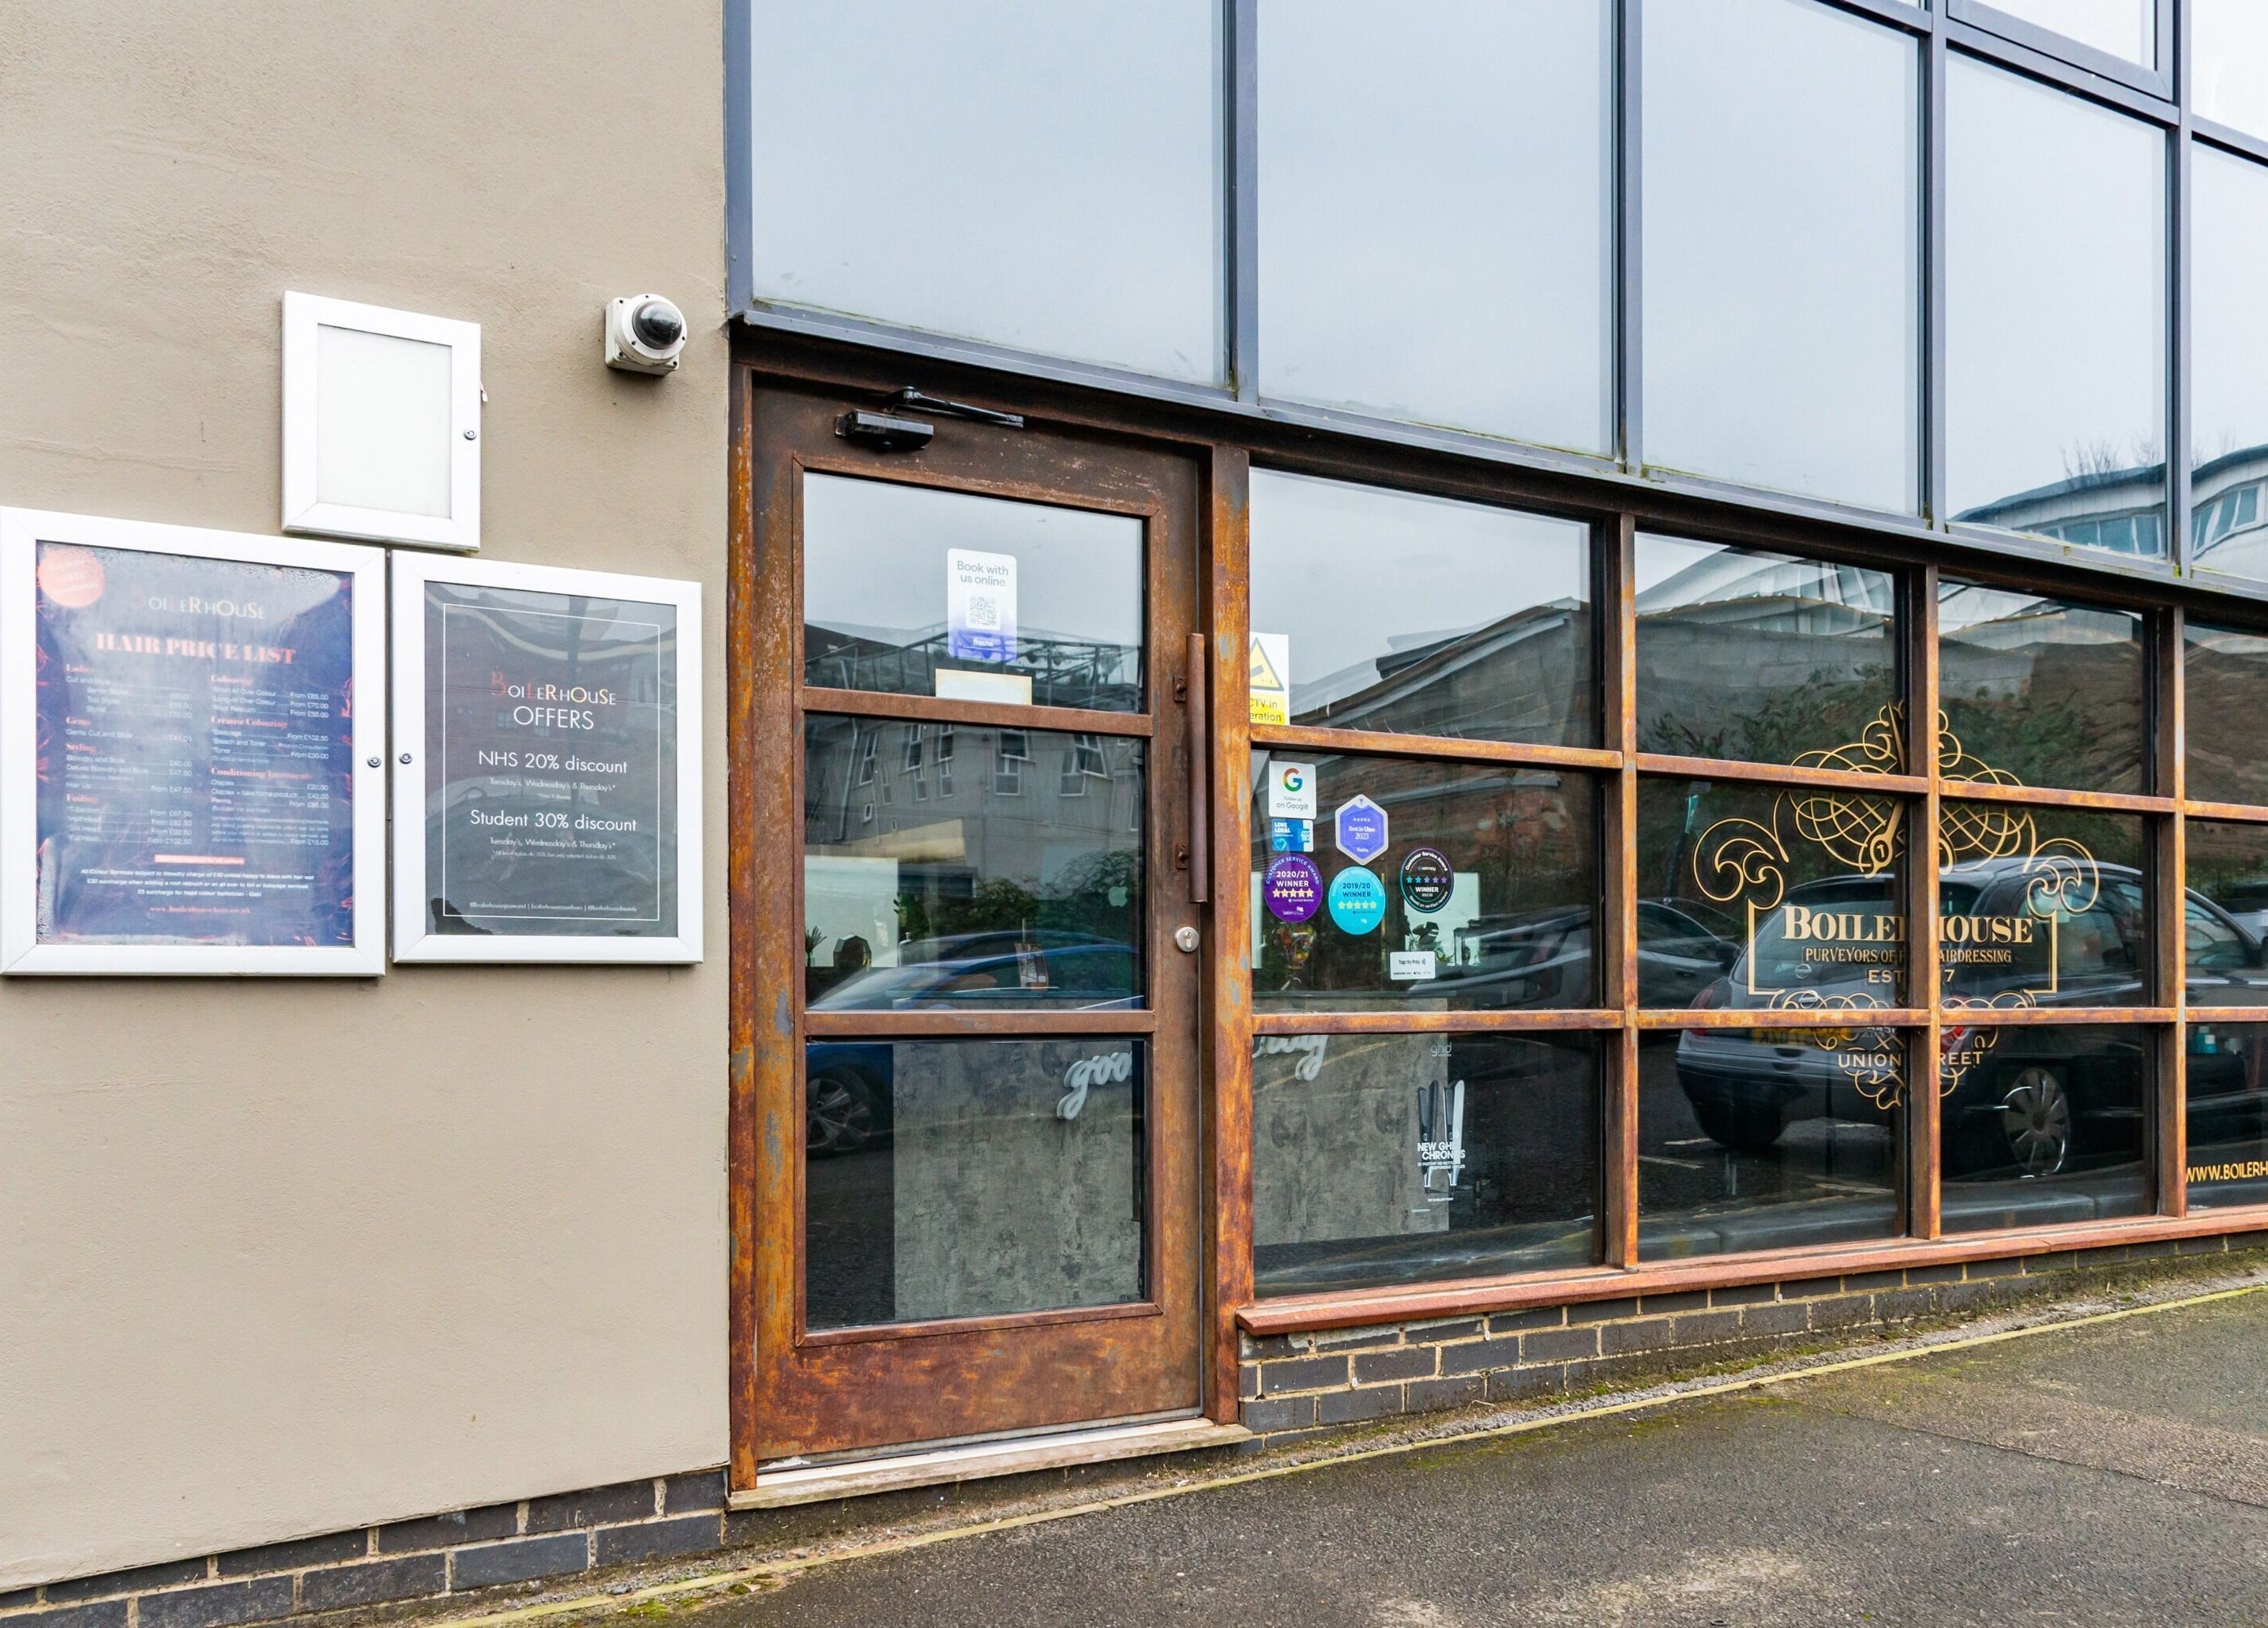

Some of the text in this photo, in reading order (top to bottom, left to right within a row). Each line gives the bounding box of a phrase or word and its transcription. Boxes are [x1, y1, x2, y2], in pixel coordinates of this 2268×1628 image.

[957, 560, 1008, 577] Book with
[960, 574, 1006, 588] us online
[96, 634, 297, 664] HAIR PRICE LIST
[1268, 700, 1278, 709] in
[513, 705, 594, 730] OFFERS
[479, 750, 628, 774] NHS 20% discount
[525, 778, 572, 790] Wednesday's
[1286, 802, 1309, 811] Google
[470, 809, 636, 832] Student 30% discount
[525, 838, 572, 849] Wednesday's
[1266, 858, 1285, 884] CUSTOMER
[1286, 856, 1308, 866] SERVICE
[1307, 864, 1320, 885] AWARD
[1805, 946, 1878, 962] PURVEYORS
[1880, 949, 1895, 962] OF
[1939, 949, 2012, 963] AIRDRESSING
[1430, 1041, 1451, 1057] ghd
[1838, 1054, 1902, 1067] UNION
[1417, 1141, 1453, 1152] NEW GH
[1421, 1149, 1466, 1160] CHRONS
